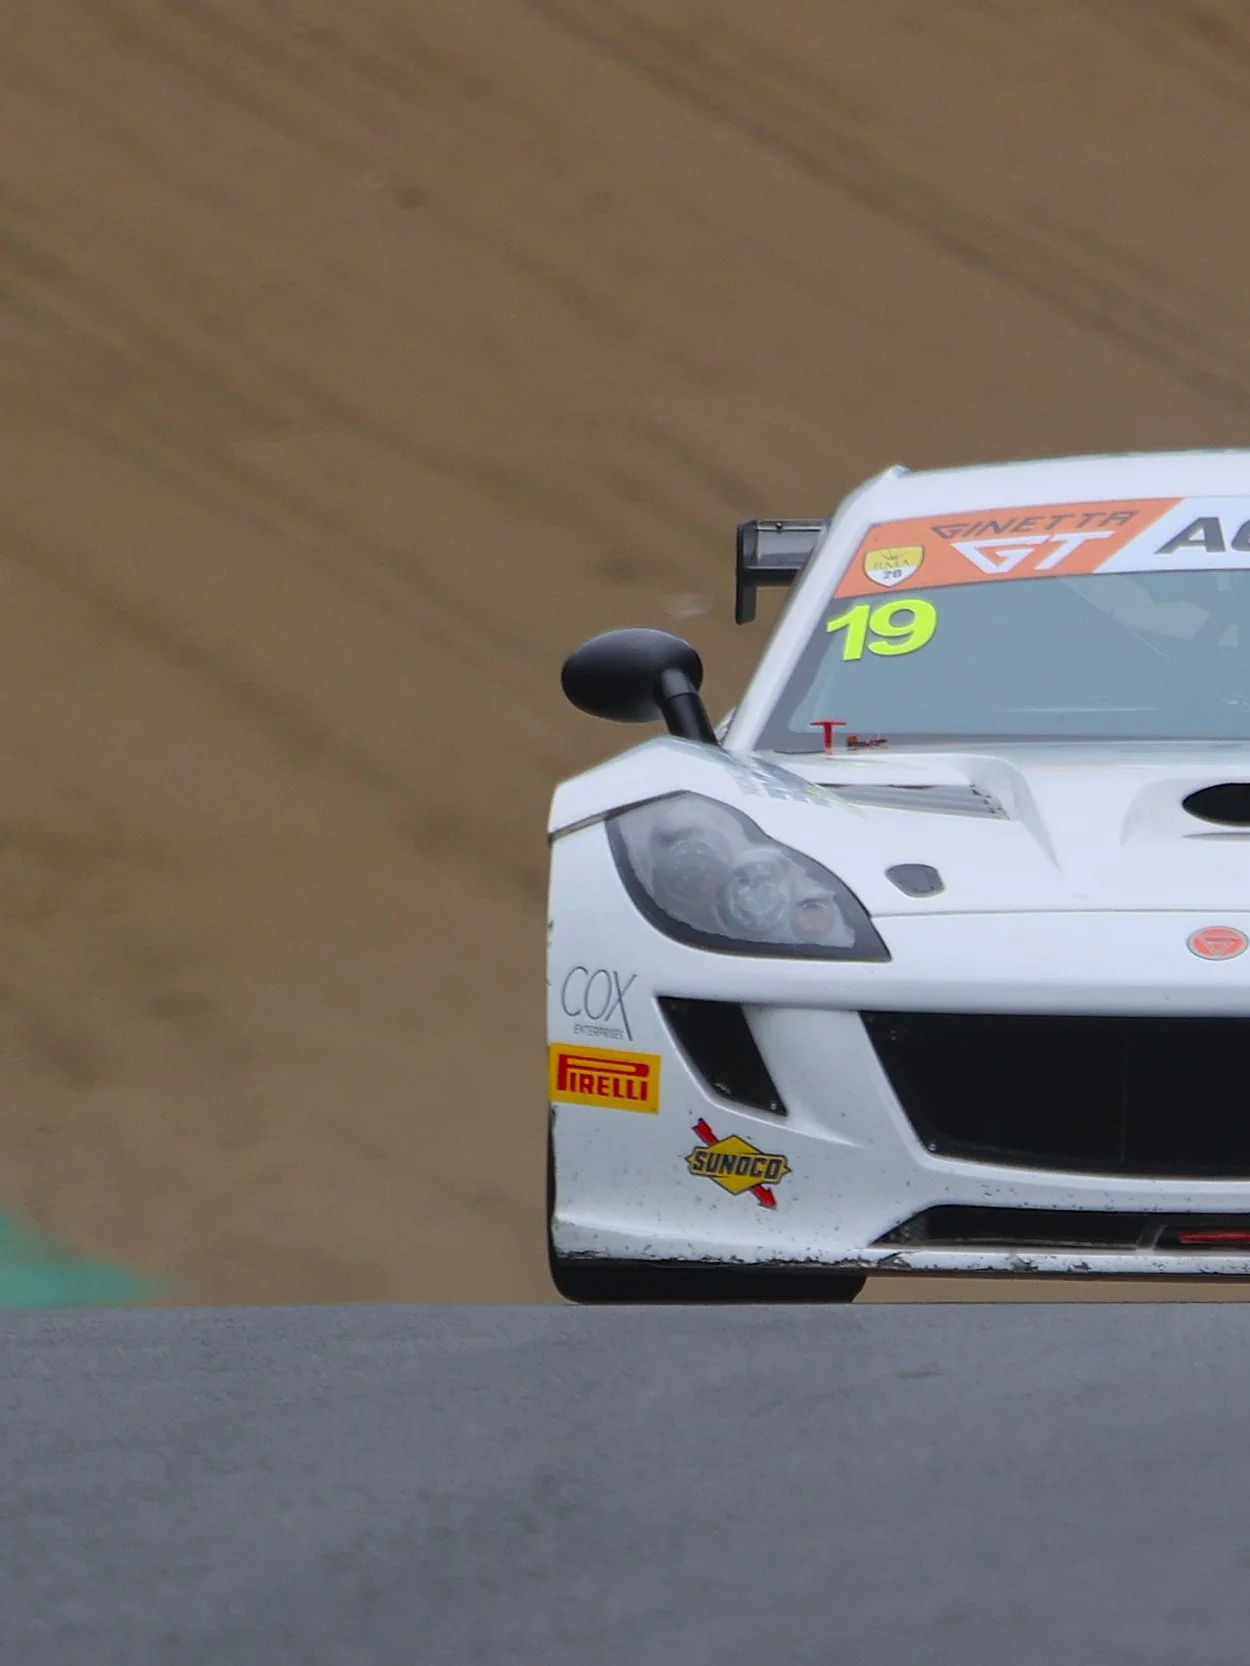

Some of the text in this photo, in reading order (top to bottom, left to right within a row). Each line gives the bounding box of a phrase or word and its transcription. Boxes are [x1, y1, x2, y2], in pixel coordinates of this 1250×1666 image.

[930, 510, 1139, 540] GINETTA
[950, 530, 1115, 574] GT
[826, 599, 939, 662] 19
[560, 966, 637, 1042] COX
[557, 1054, 650, 1101] PIRELLI
[691, 1151, 784, 1180] SUNOCO
